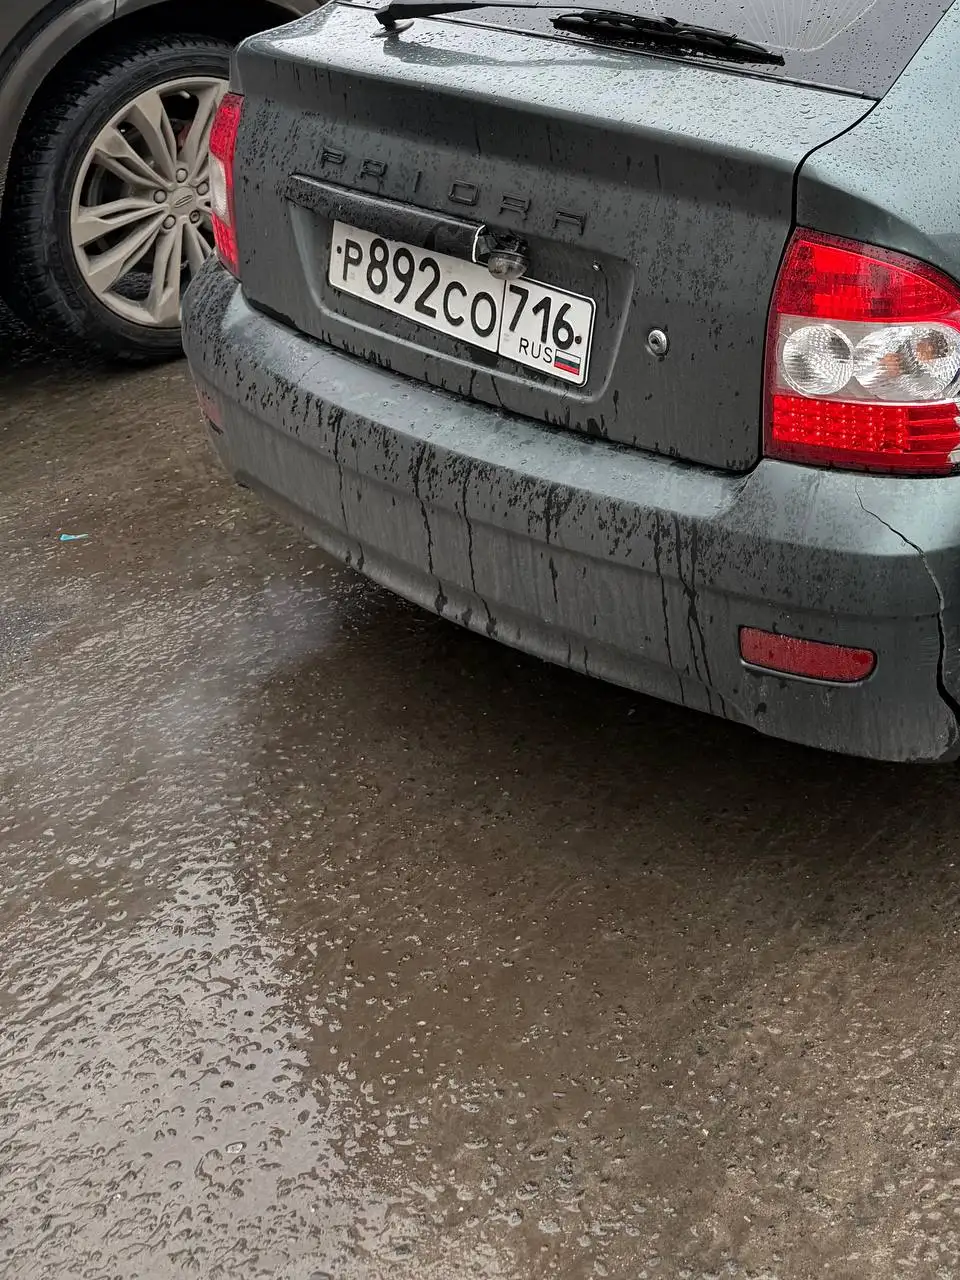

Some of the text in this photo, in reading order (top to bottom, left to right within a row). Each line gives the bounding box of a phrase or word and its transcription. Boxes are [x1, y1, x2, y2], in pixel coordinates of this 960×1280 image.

[320, 146, 587, 235] PRIORA
[343, 238, 575, 350] Р892СО 716
[518, 337, 553, 364] RUS
